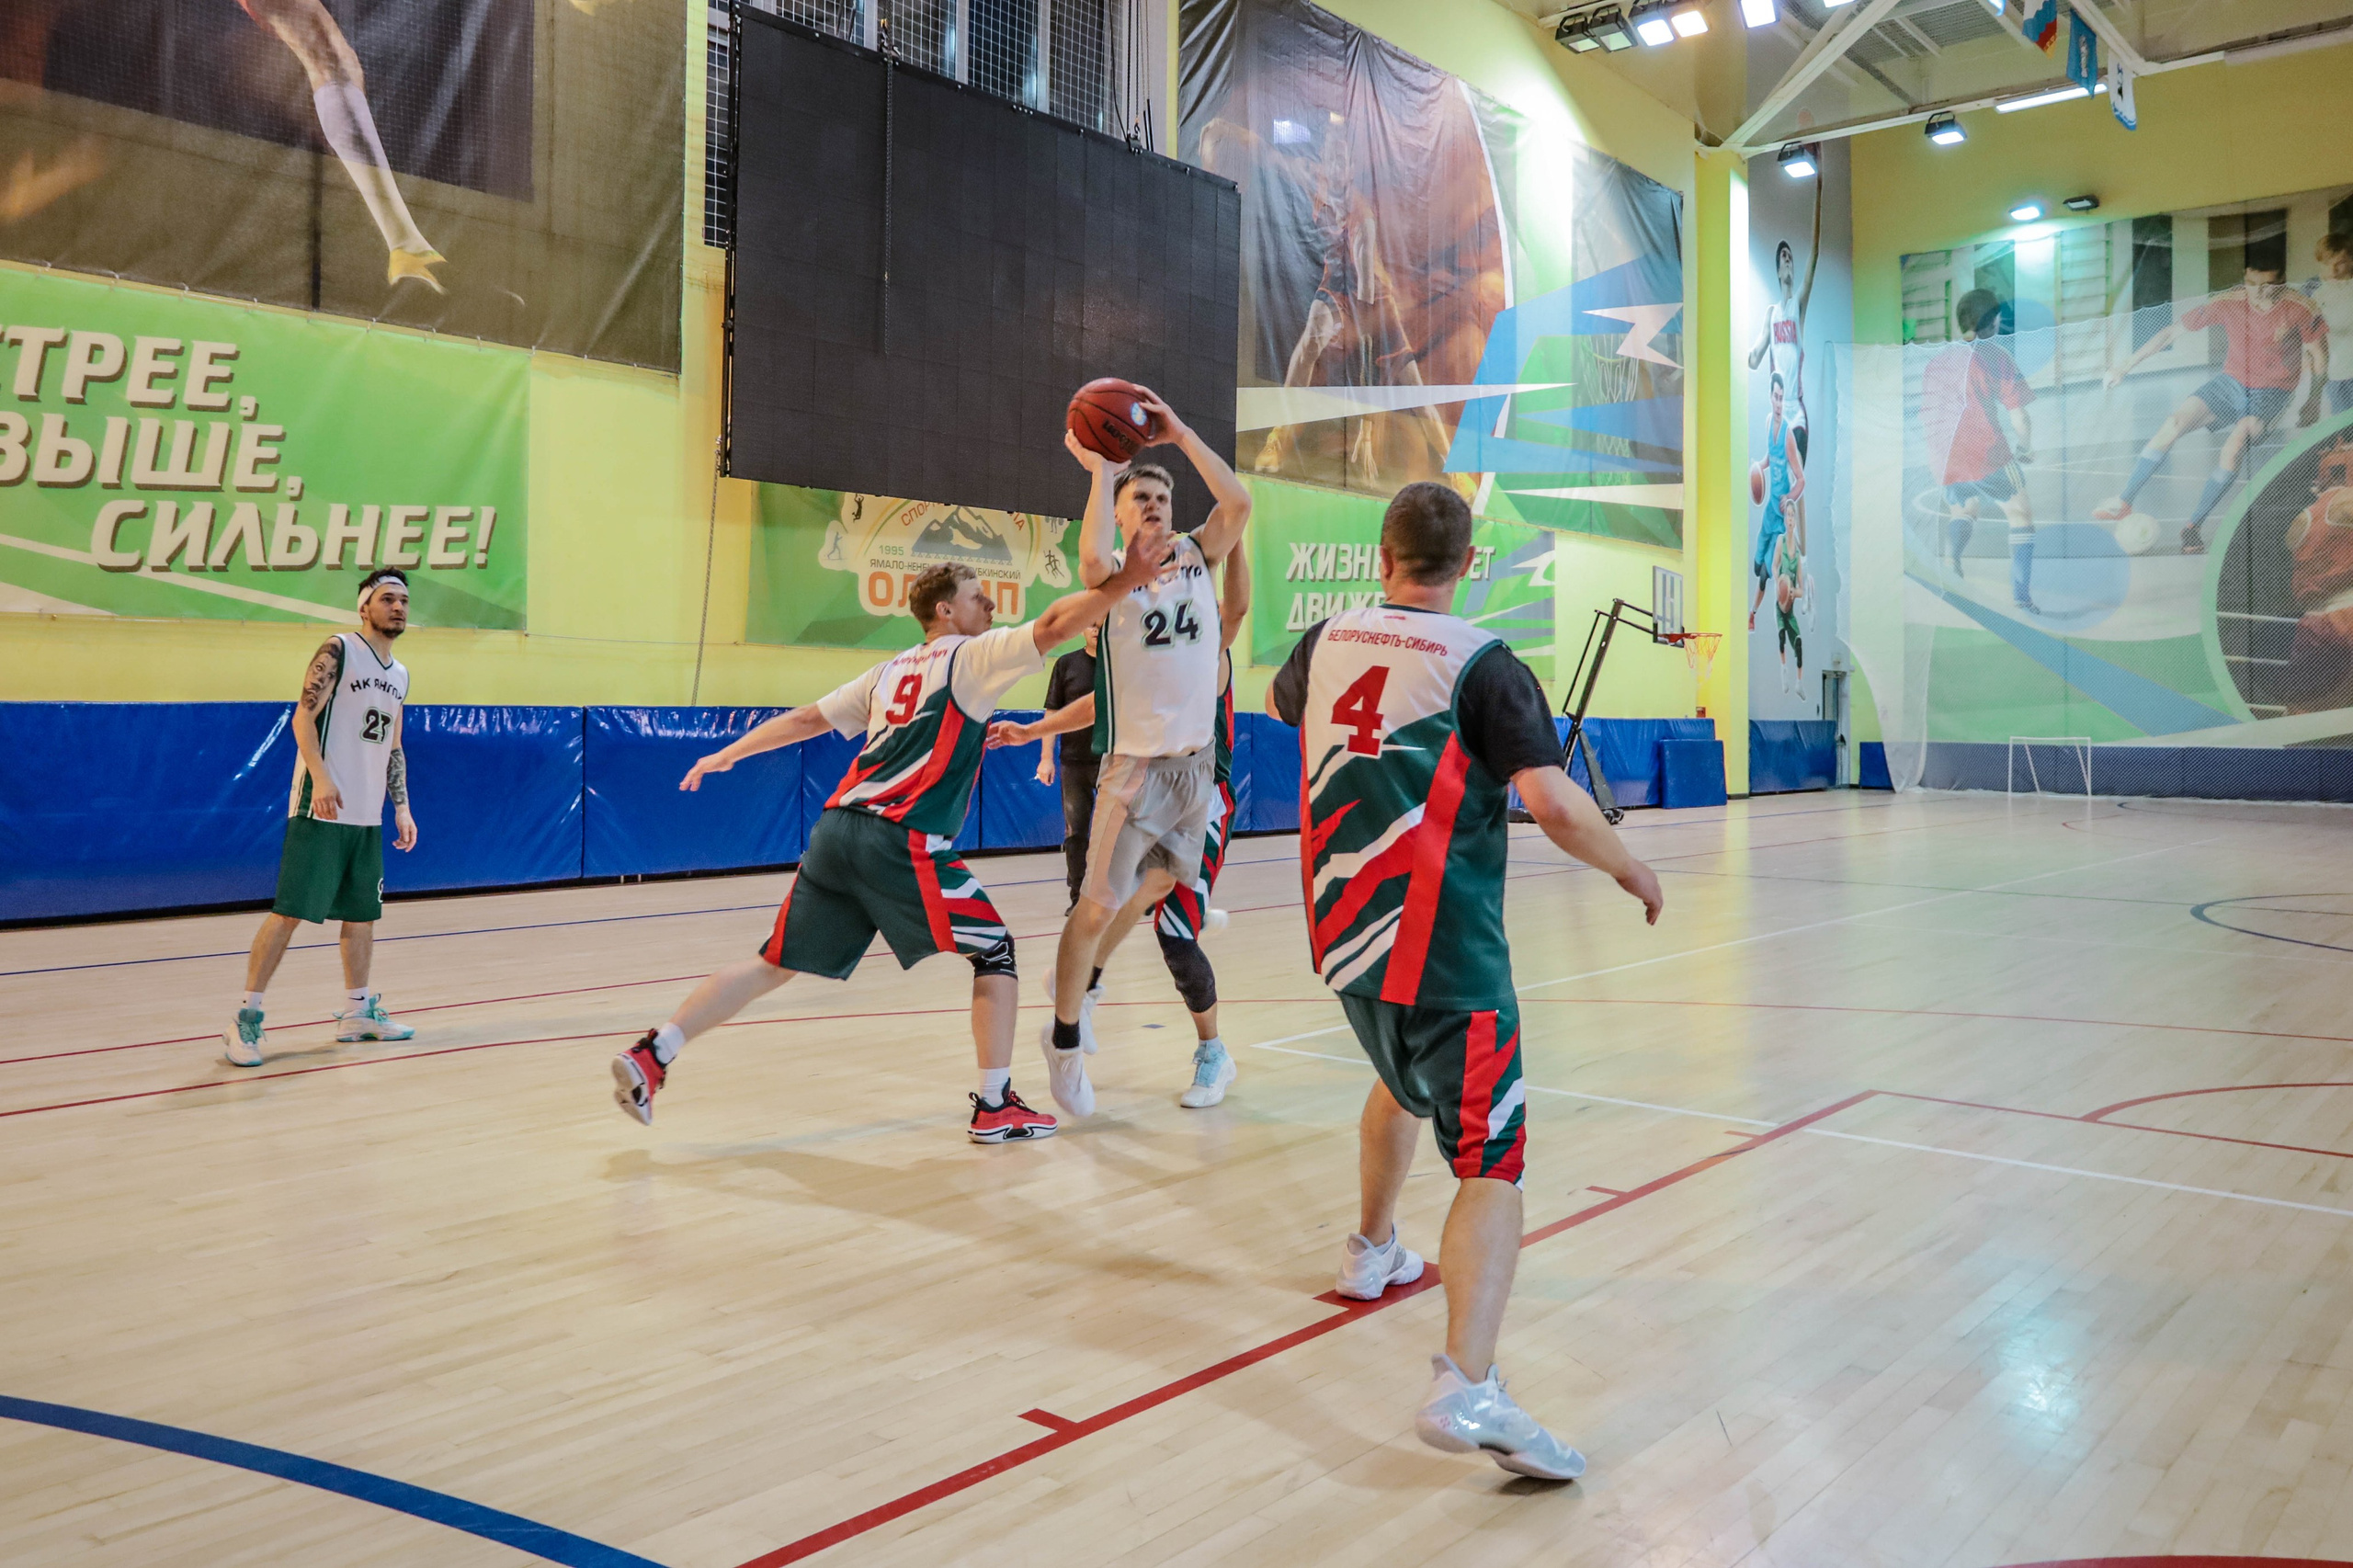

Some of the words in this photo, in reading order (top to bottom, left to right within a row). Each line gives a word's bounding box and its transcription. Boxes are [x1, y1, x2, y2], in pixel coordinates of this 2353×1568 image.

[0, 324, 258, 421] ТРЕЕ,
[91, 499, 497, 572] СИЛЬНЕЕ!
[879, 545, 904, 555] 1995
[868, 571, 1019, 615] ОЛП
[1143, 603, 1199, 645] 24
[1327, 629, 1448, 656] БЕЛОРУСНЕФТЬ-СИБИРЬ
[350, 677, 370, 692] НК
[885, 673, 923, 725] 9
[1330, 665, 1391, 757] 4
